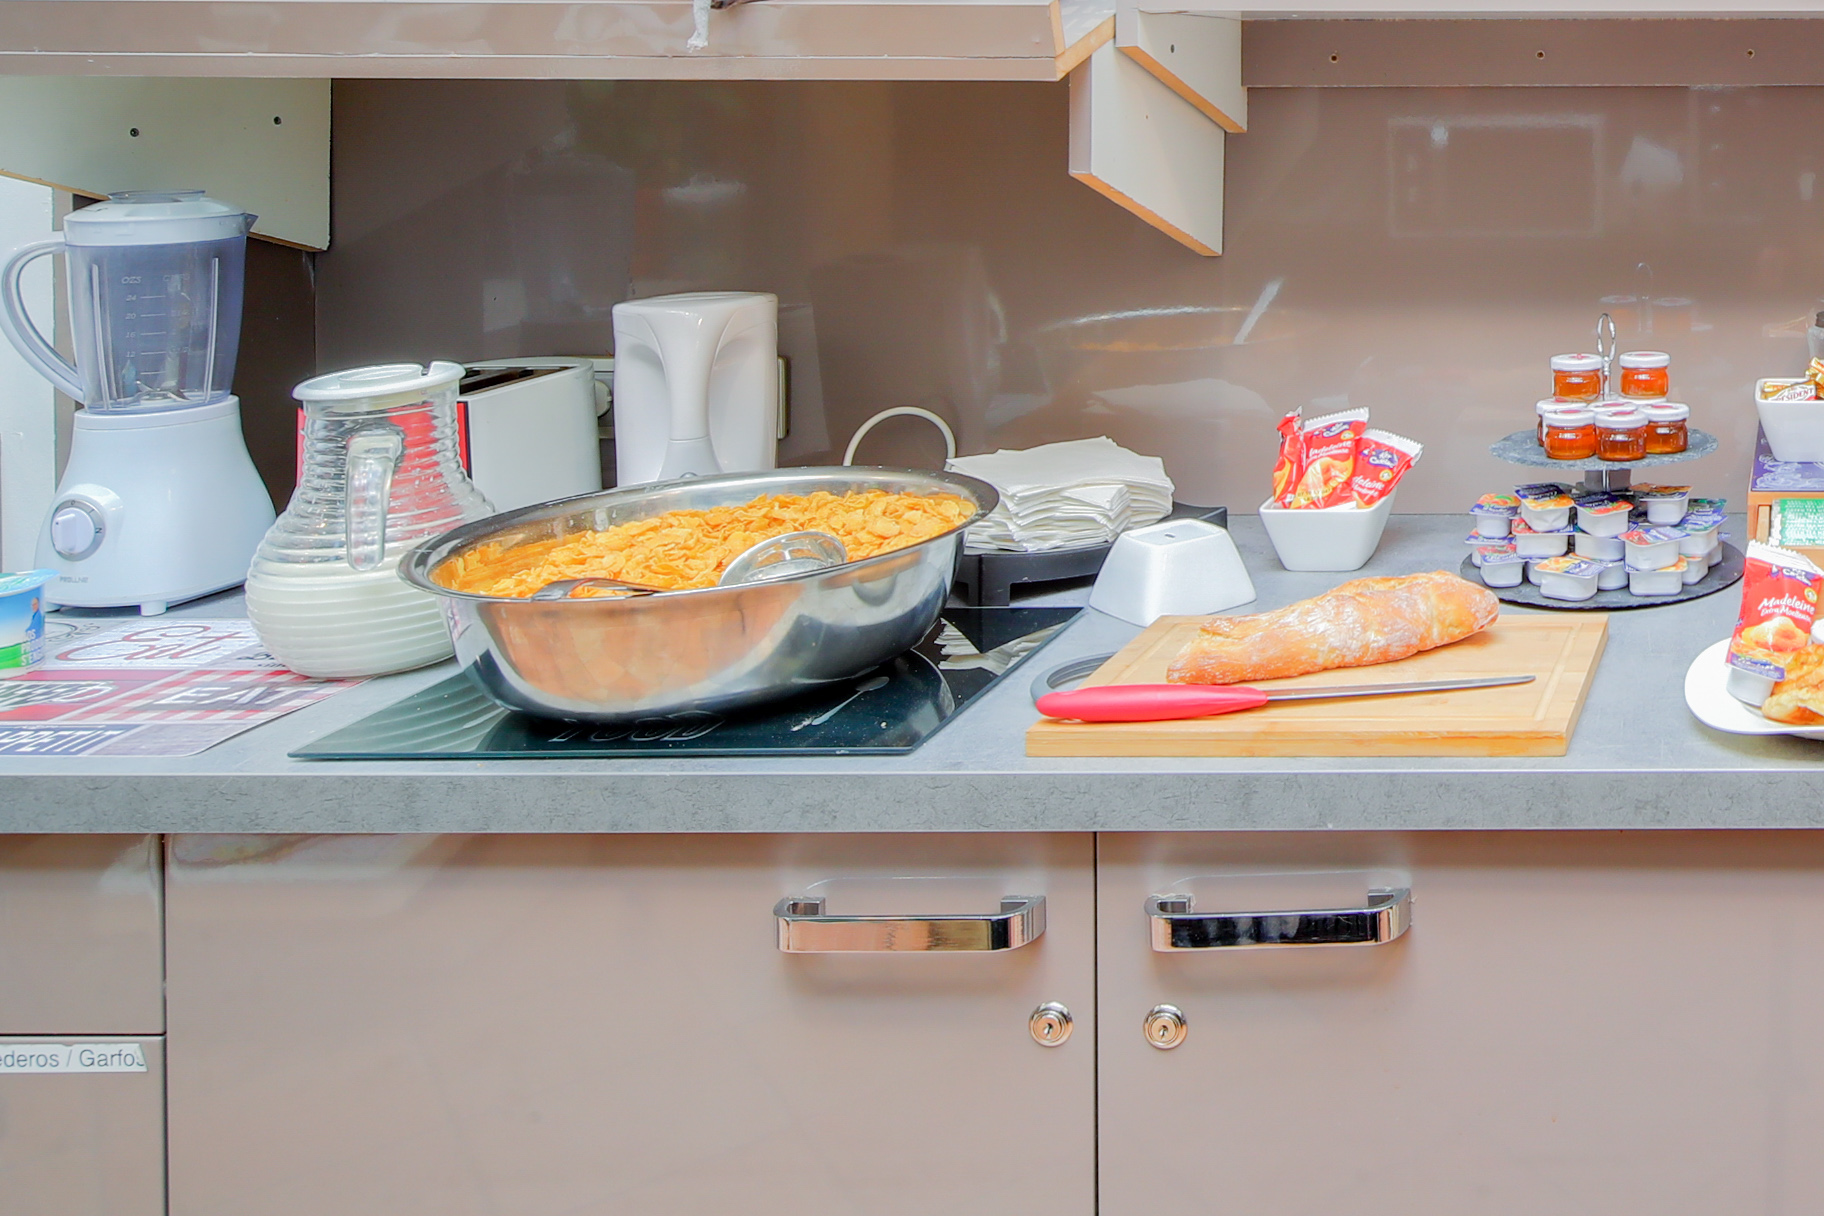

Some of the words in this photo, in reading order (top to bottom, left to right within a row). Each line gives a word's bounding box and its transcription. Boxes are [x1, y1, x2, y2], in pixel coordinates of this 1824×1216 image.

[1757, 593, 1816, 615] Madeleine
[1760, 605, 1780, 617] Extra
[55, 625, 250, 661] Eat
[153, 685, 324, 706] EAT
[0, 730, 125, 752] PPETIT
